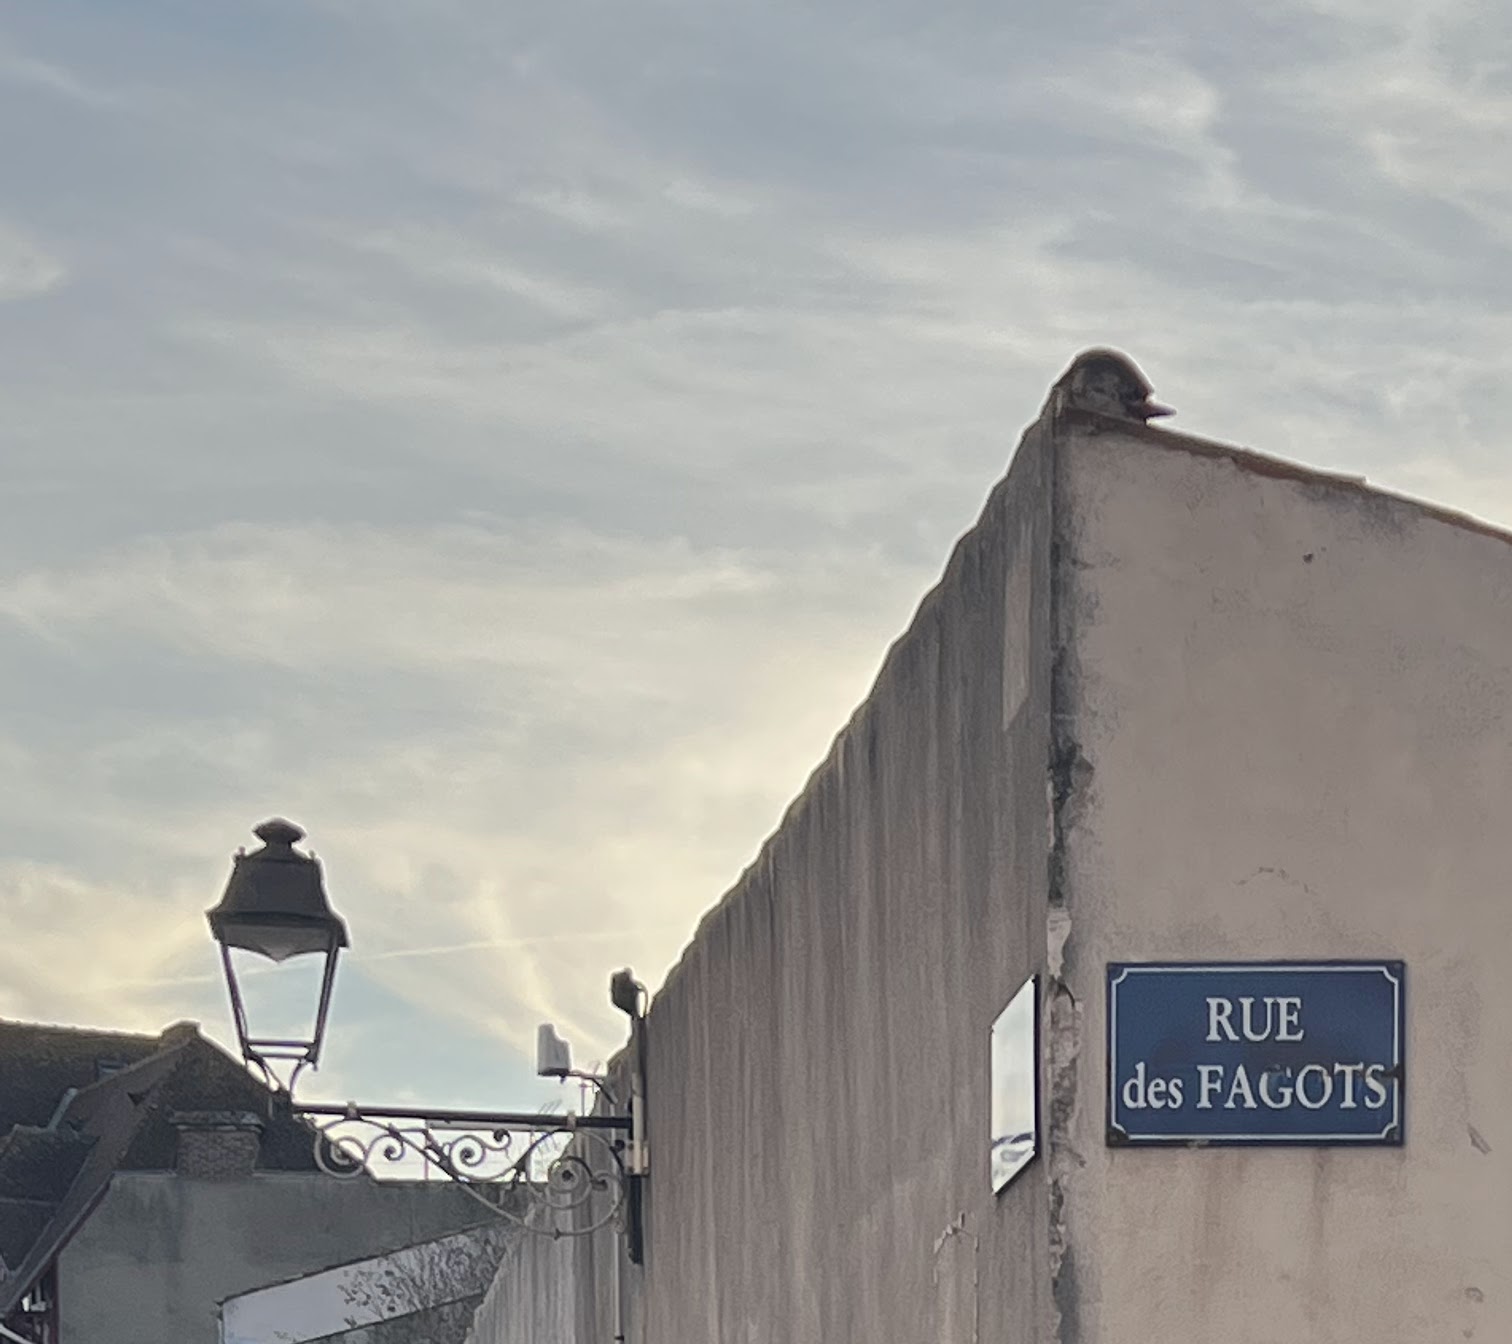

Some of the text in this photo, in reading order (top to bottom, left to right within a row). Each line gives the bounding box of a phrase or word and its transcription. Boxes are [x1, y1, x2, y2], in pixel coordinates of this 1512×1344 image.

[1206, 997, 1305, 1042] RUE
[1122, 1061, 1388, 1110] des FAGOTS
